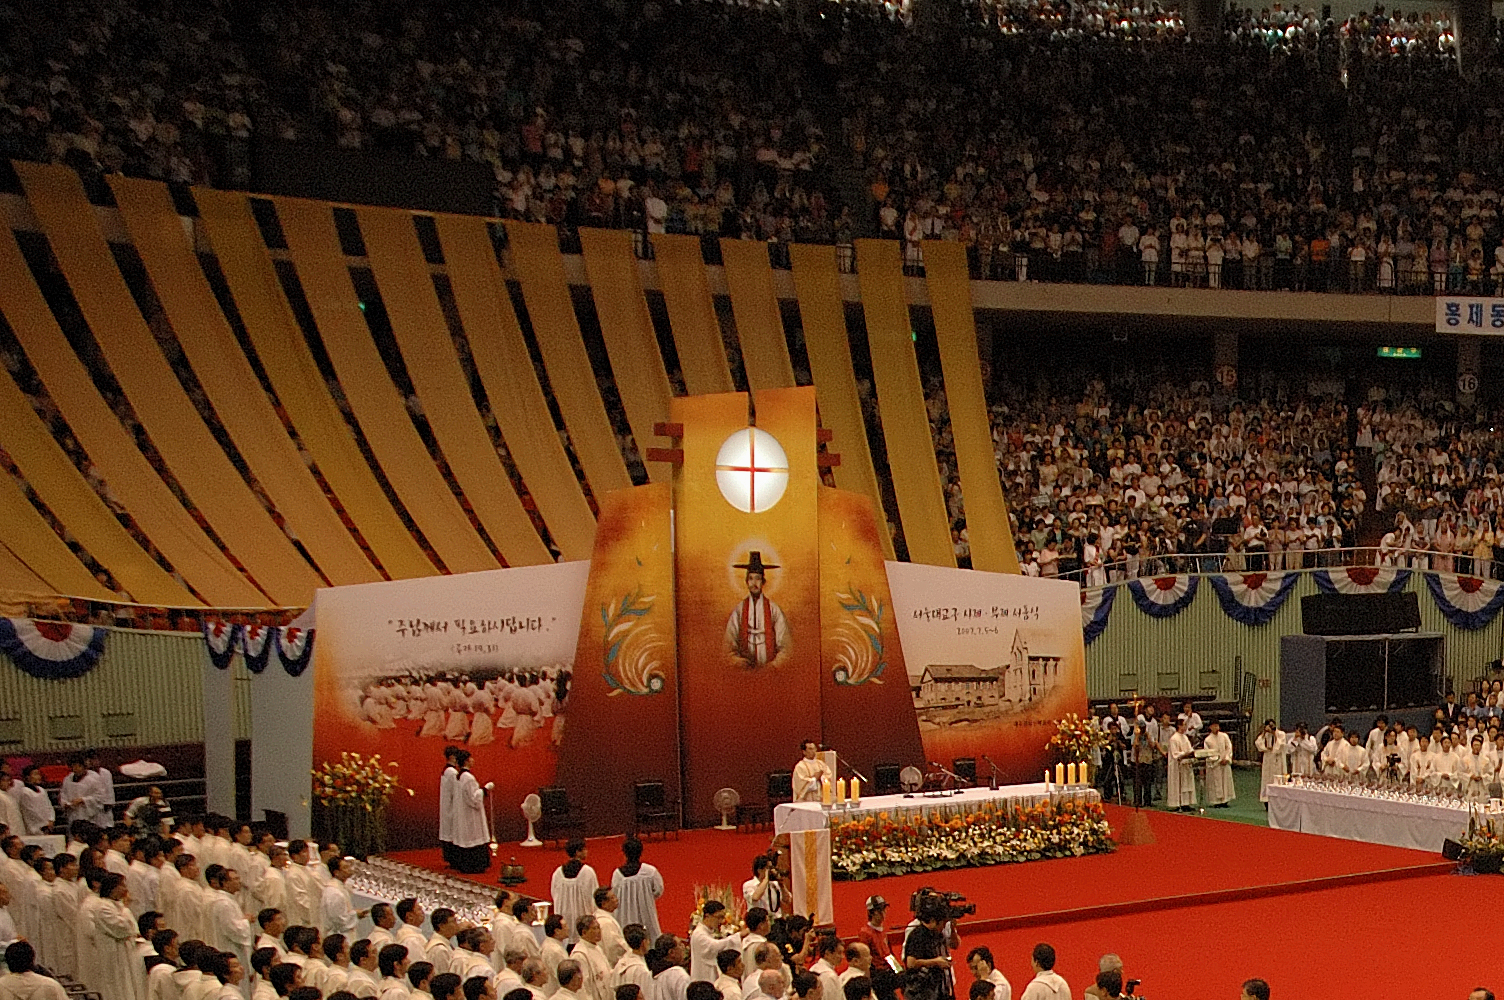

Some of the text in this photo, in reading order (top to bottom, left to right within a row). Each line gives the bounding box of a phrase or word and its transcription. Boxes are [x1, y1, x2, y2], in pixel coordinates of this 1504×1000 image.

[1461, 377, 1476, 390] 16
[912, 607, 959, 622] 서울대교구
[1012, 605, 1039, 621] 서품식
